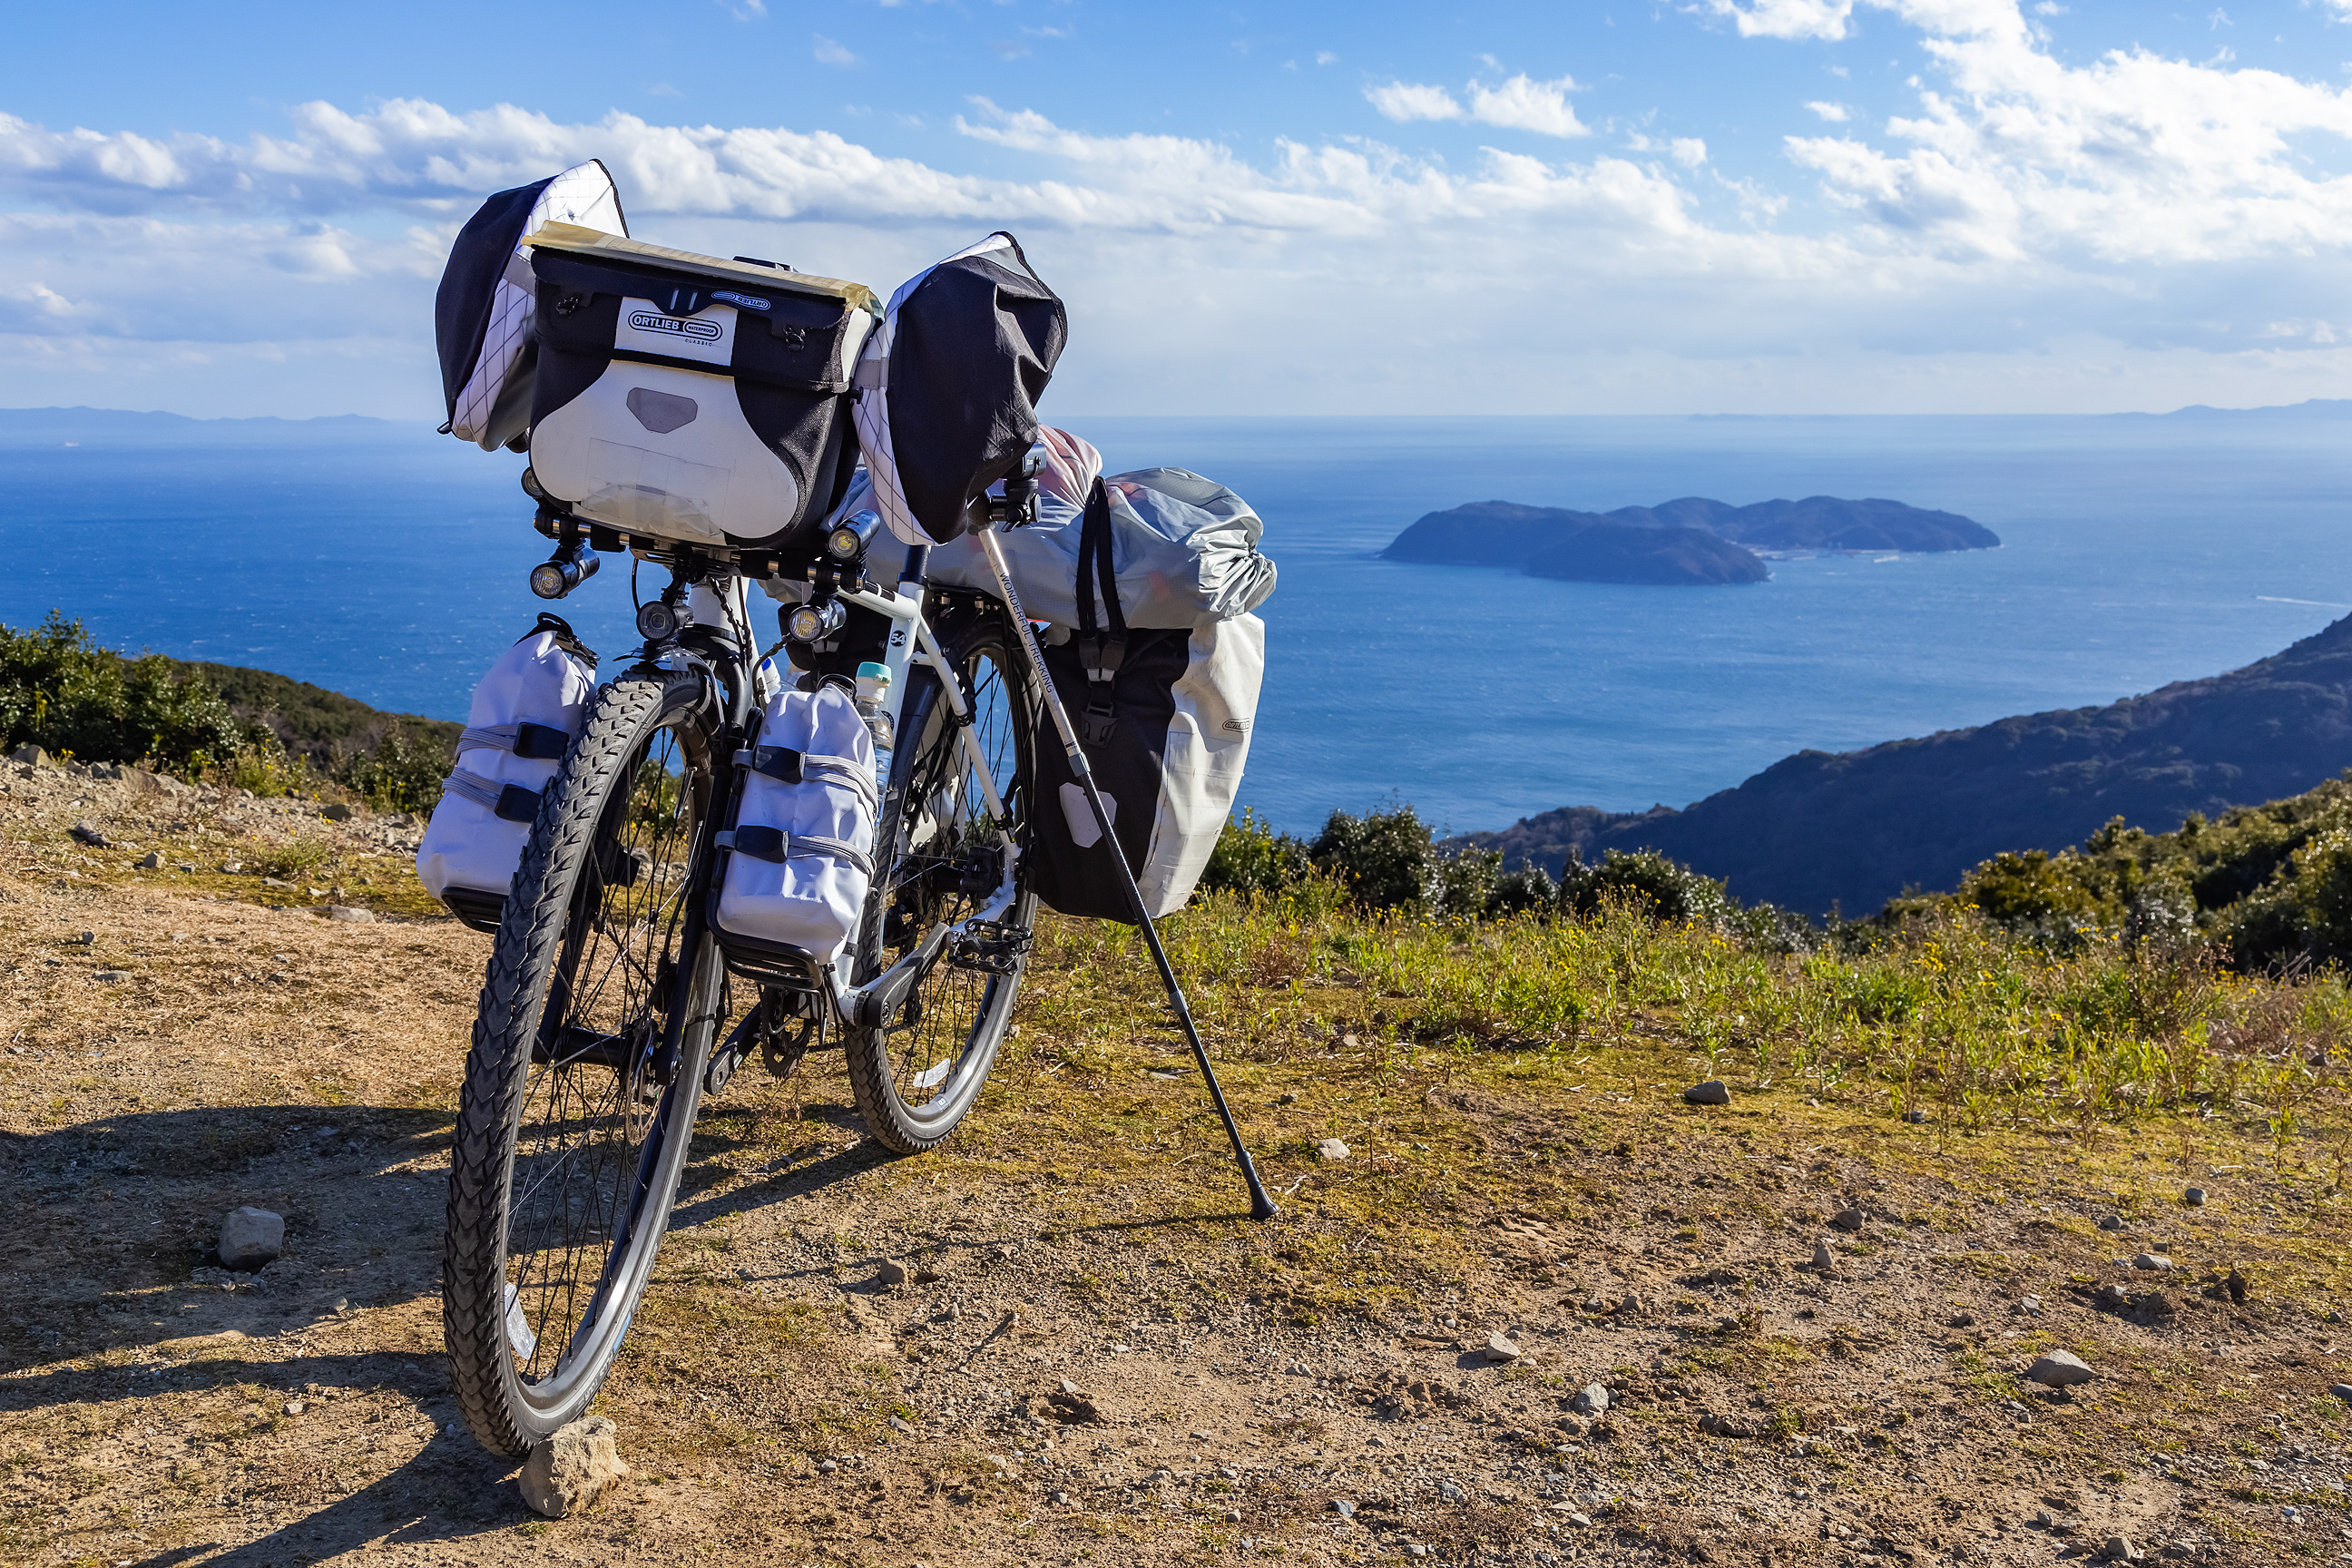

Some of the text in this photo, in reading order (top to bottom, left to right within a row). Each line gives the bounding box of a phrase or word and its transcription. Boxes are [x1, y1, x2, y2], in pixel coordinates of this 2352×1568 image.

[633, 315, 715, 335] ORTLIEB WATERPROOF
[890, 632, 906, 645] 54
[998, 572, 1055, 693] WONDERFUL TREKKING
